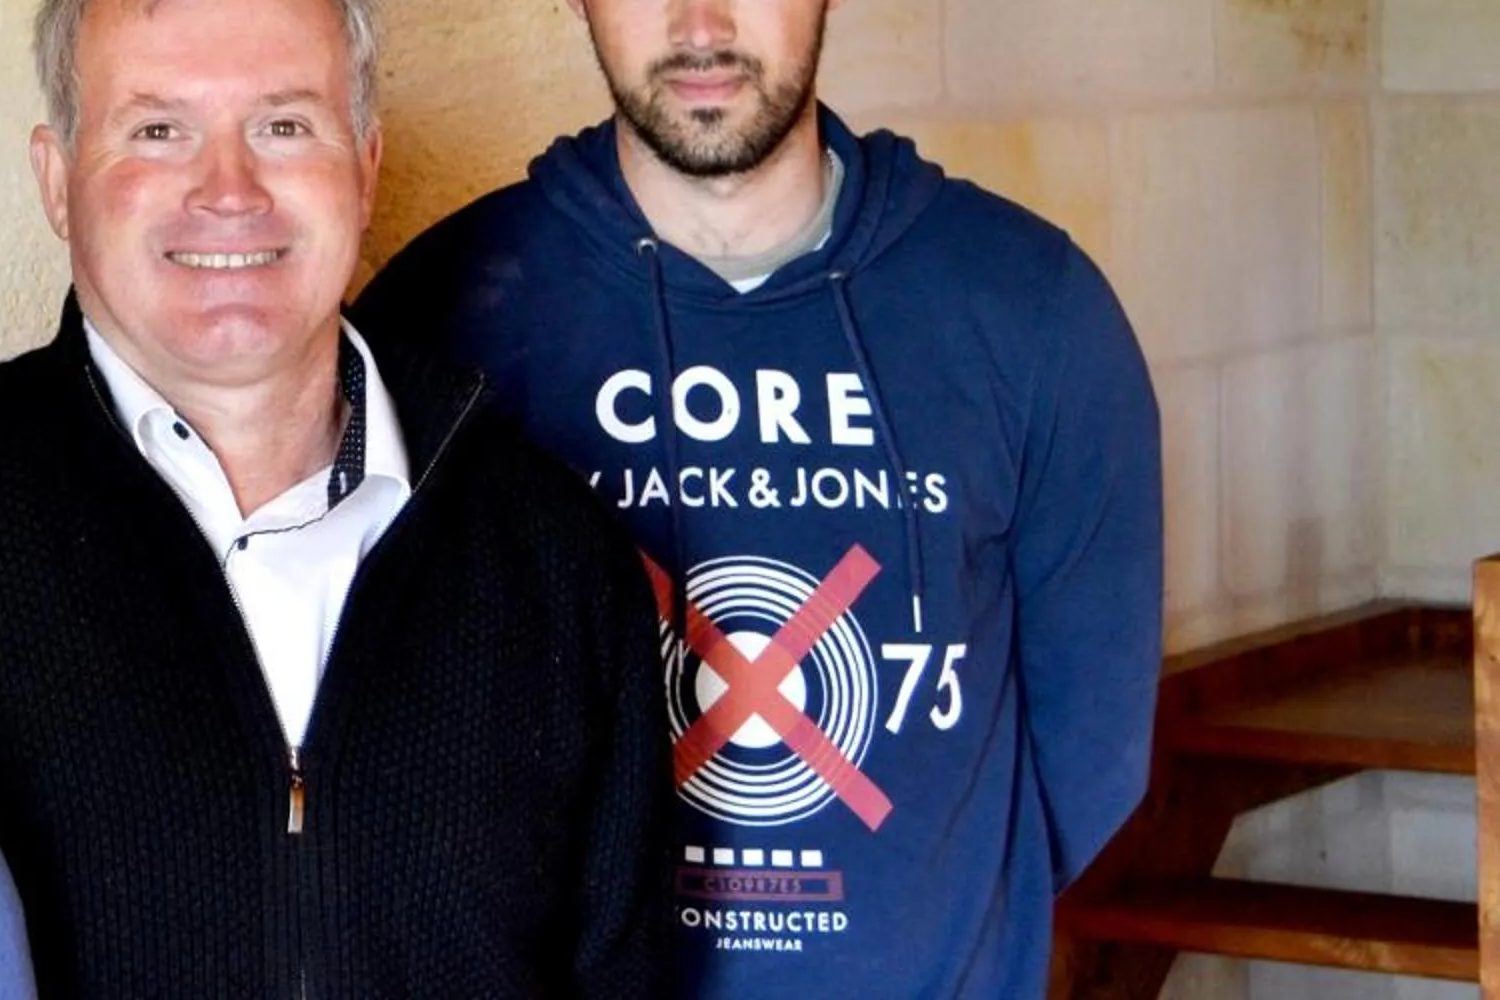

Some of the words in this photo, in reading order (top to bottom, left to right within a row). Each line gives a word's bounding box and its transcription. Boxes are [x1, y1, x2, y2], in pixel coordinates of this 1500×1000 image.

[595, 365, 875, 446] CORE
[881, 642, 967, 736] 75
[676, 906, 848, 932] ONSTRUCTED
